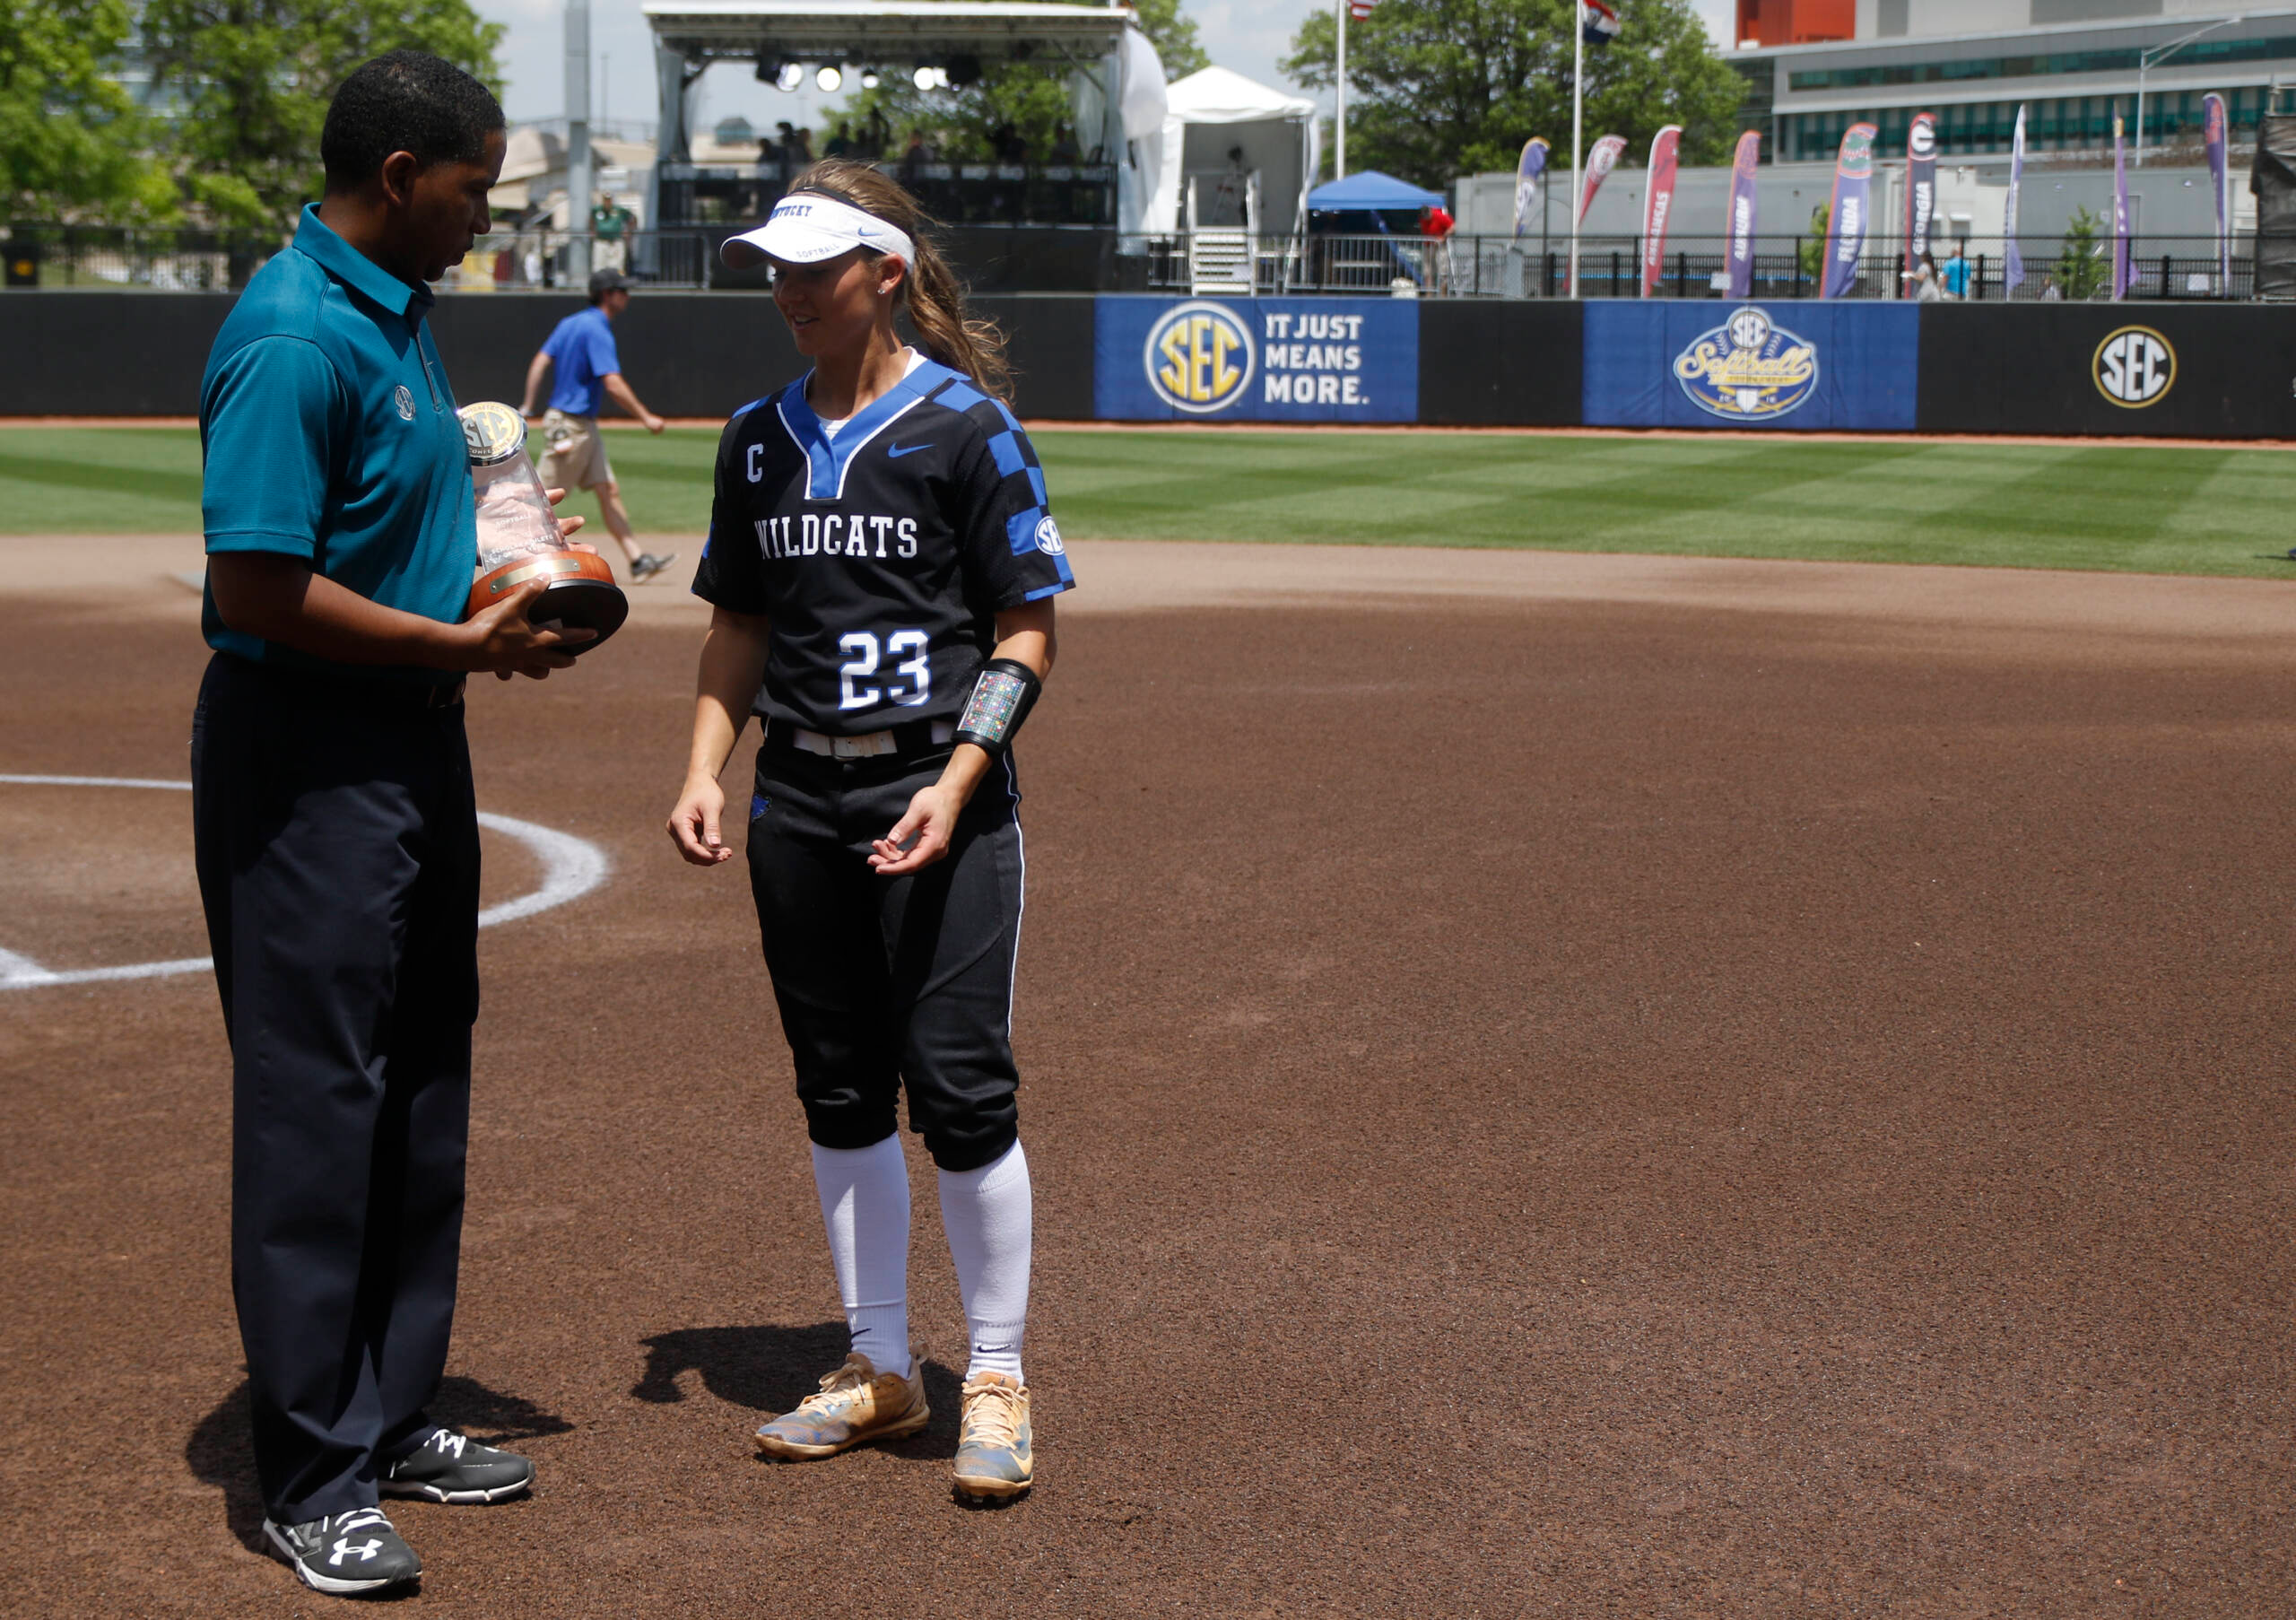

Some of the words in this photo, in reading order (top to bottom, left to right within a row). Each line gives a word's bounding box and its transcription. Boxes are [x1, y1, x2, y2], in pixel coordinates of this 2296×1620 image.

[1648, 191, 1670, 266] ARKANSAS
[1734, 195, 1750, 262] AUBURN
[1837, 196, 1859, 263] FLORIDA
[1912, 181, 1932, 256] GEORGIA
[796, 244, 839, 258] SOFTBALL
[1265, 314, 1291, 339] IT
[1293, 315, 1363, 341] JUST
[1732, 315, 1767, 349] SEC
[1159, 316, 1241, 402] SEC
[1265, 344, 1361, 370] MEANS
[1677, 341, 1813, 380] Softball
[2100, 332, 2167, 401] SEC
[396, 388, 413, 418] SEC
[1265, 373, 1370, 405] MORE.
[462, 412, 509, 448] SEC
[747, 443, 763, 483] C
[754, 514, 918, 560] WILDCATS
[839, 630, 931, 710] 23
